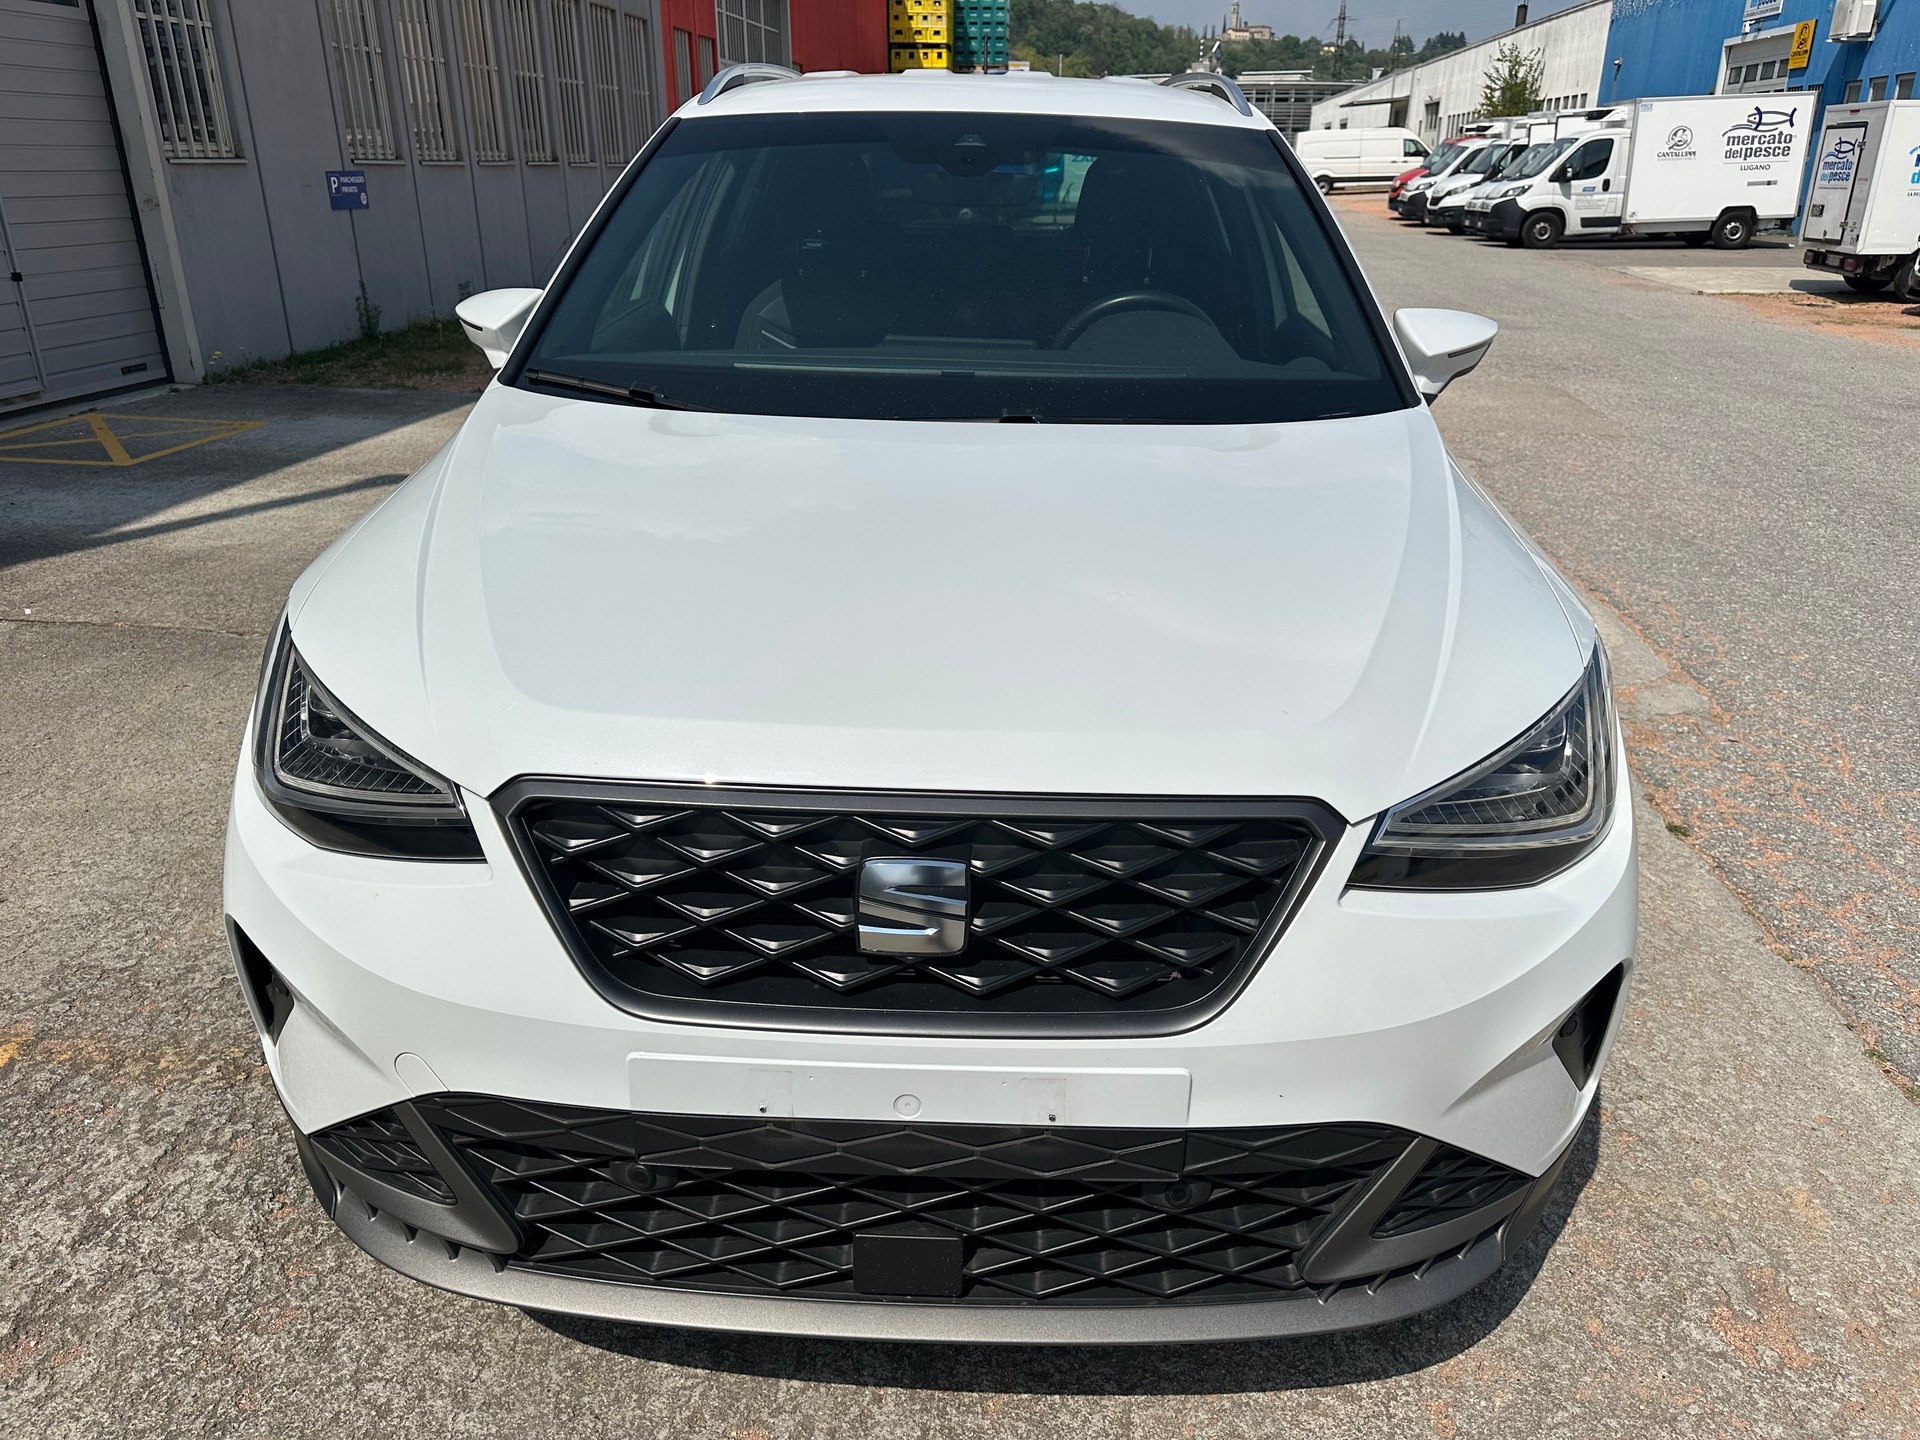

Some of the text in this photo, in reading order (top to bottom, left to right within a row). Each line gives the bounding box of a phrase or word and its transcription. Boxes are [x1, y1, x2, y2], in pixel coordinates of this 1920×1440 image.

[1726, 131, 1793, 146] mercato
[1823, 158, 1853, 170] mercato
[330, 177, 338, 193] P
